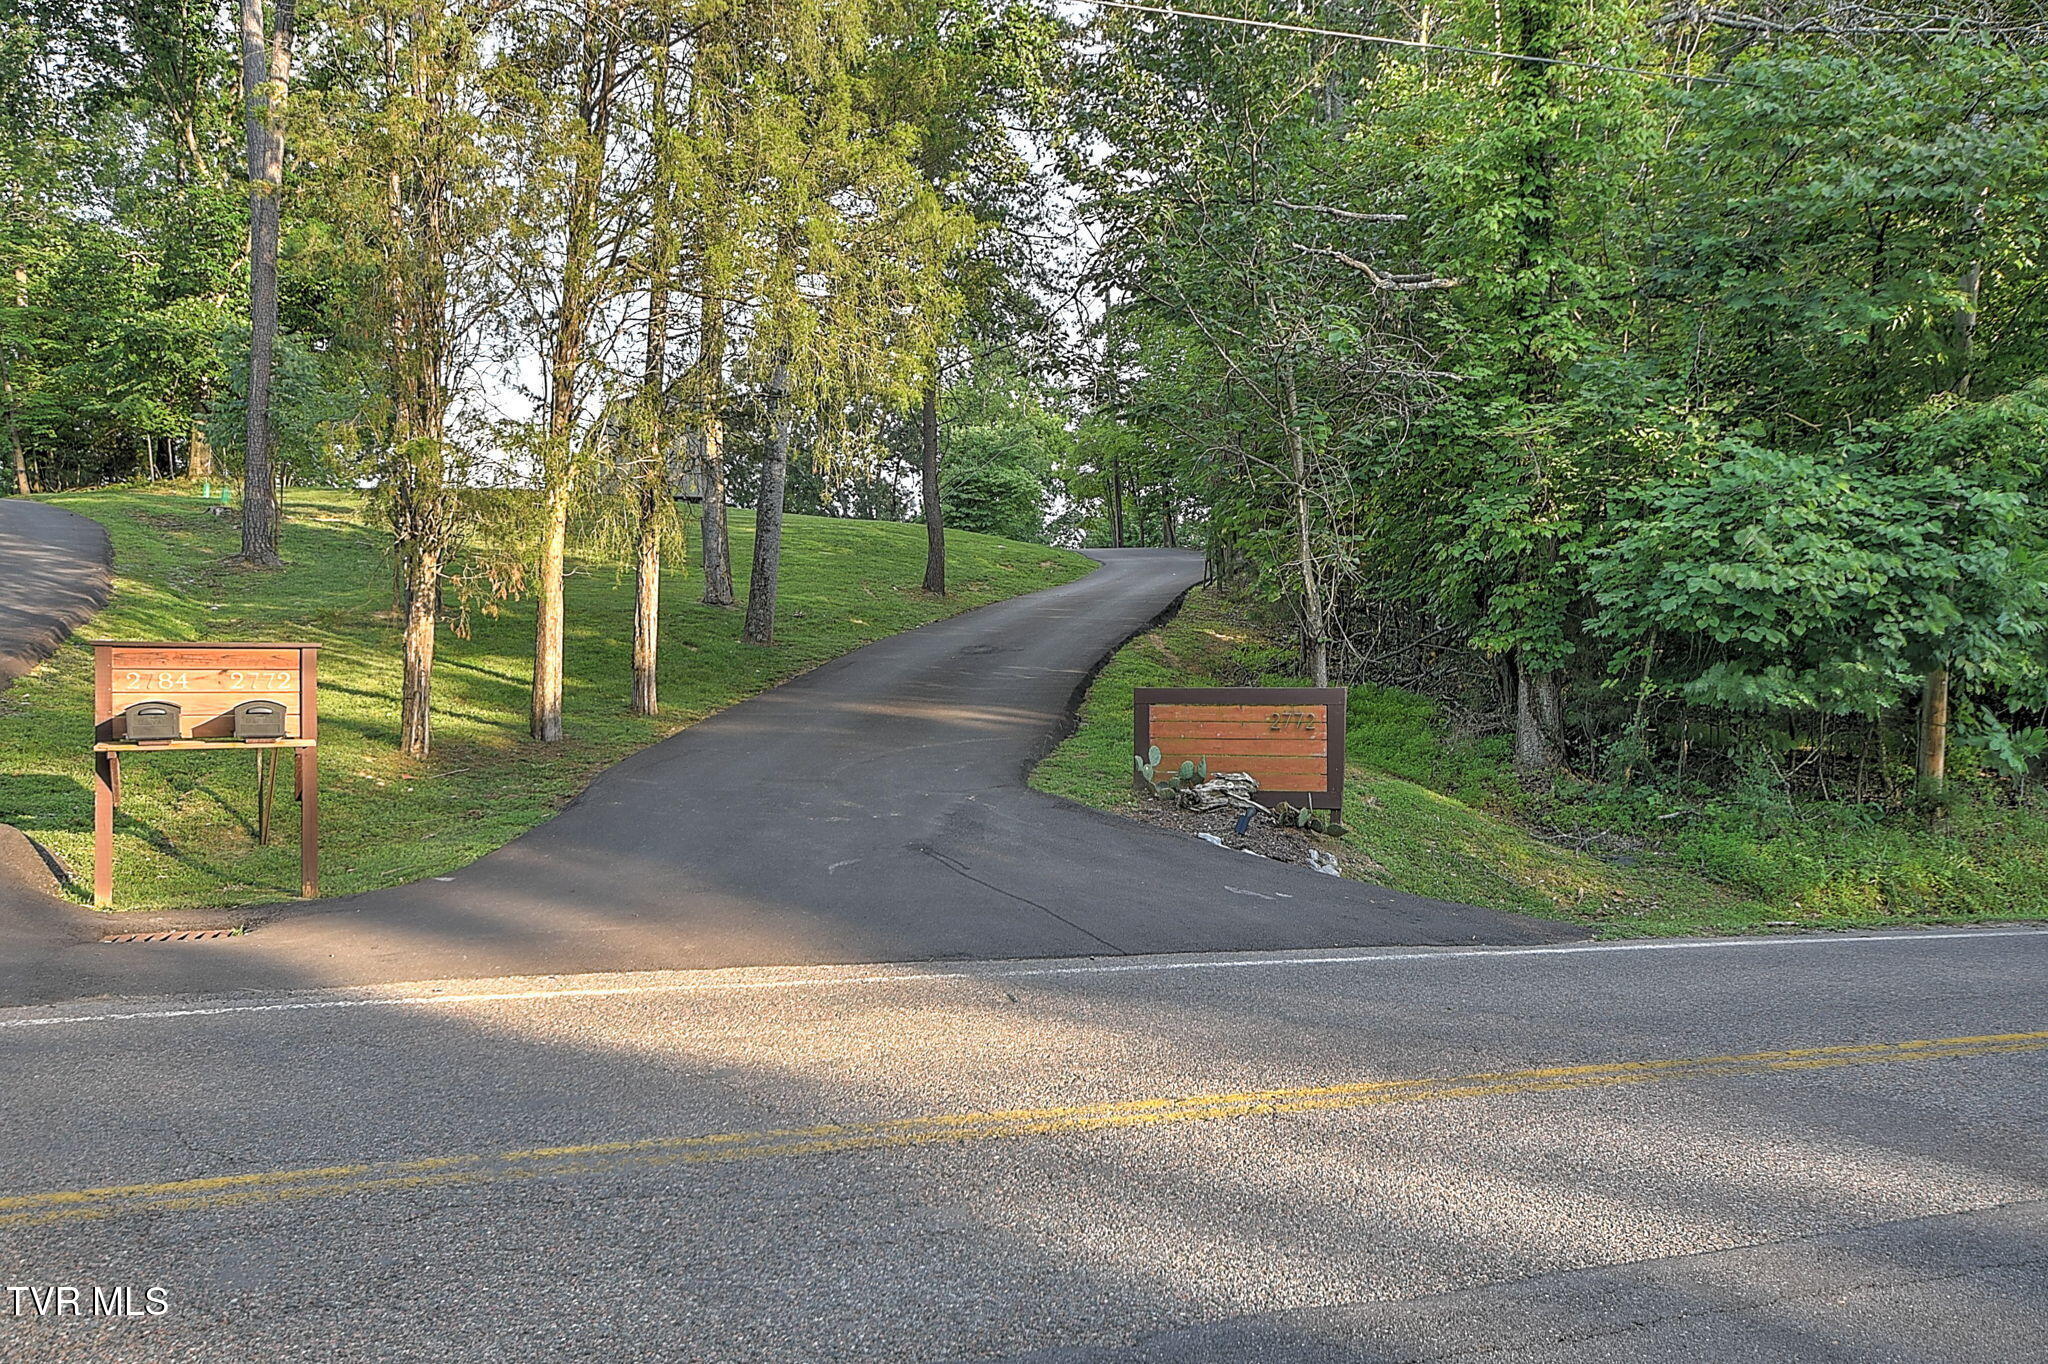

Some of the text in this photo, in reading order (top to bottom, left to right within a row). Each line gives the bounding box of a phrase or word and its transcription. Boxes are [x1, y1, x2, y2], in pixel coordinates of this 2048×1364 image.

[126, 672, 189, 690] 2784
[230, 672, 291, 690] 2772
[1270, 712, 1316, 731] 2772
